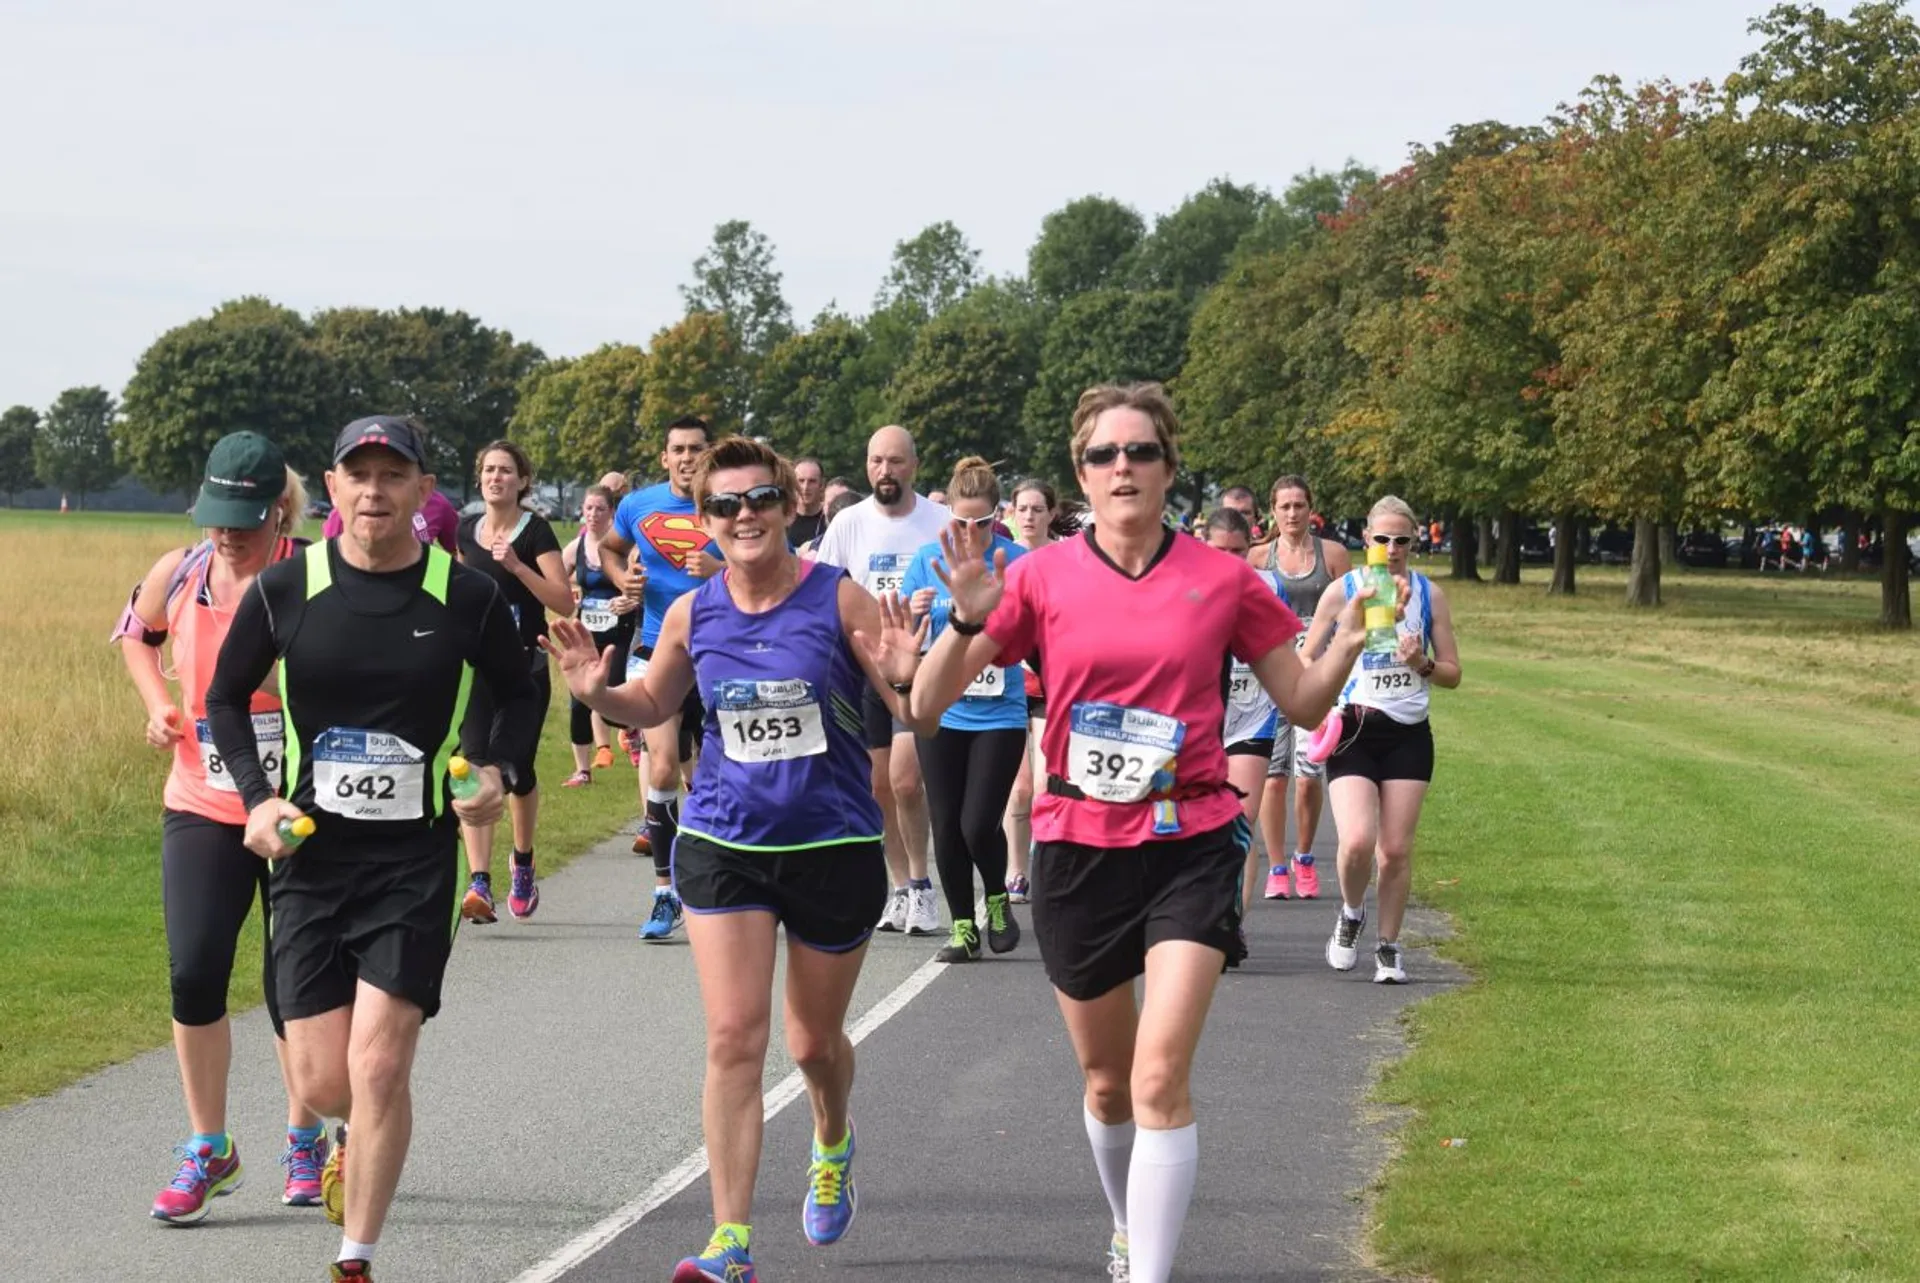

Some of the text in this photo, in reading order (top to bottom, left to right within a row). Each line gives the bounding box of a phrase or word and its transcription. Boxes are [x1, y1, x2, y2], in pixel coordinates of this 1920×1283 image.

[974, 670, 996, 685] 06
[1371, 672, 1412, 690] 7932
[760, 684, 802, 694] DUBLIN
[733, 716, 802, 743] 1653
[1127, 712, 1173, 730] DUBLIN
[1105, 729, 1125, 740] HALF
[209, 751, 278, 774] 86
[1086, 750, 1144, 782] 392
[336, 774, 396, 800] 642
